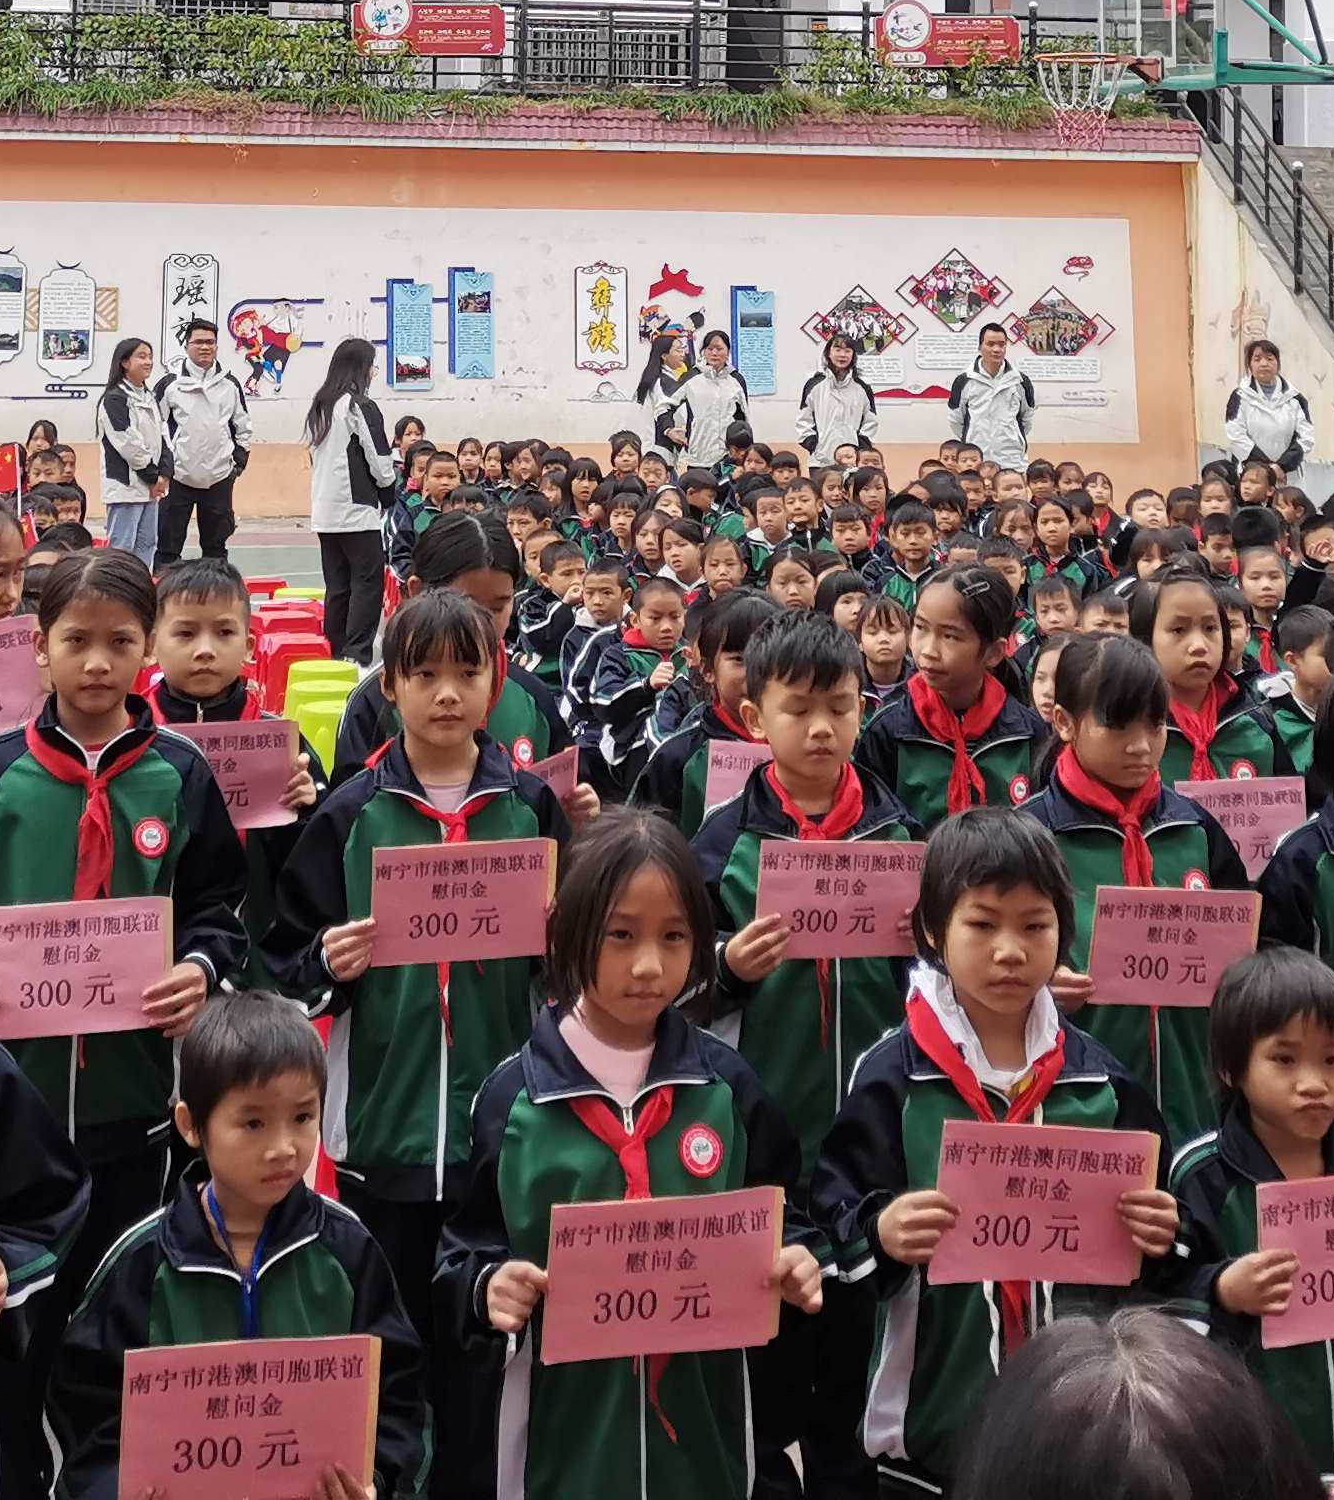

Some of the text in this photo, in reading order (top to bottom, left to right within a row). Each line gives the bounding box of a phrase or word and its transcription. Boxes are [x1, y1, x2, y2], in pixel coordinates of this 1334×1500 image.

[581, 276, 619, 355] 彝族
[224, 781, 249, 807] 元
[1195, 790, 1302, 808] 市港澳同胞联谊
[1250, 836, 1273, 860] 元
[376, 855, 544, 880] 南宁市港澳同胞联谊
[762, 851, 923, 876] 南宁市港澳同胞联谊
[432, 881, 487, 899] 慰问金
[814, 877, 867, 896] 慰问金
[408, 908, 500, 938] 300 元
[791, 906, 875, 934] 300 元
[1098, 901, 1251, 924] 南宁市港澳同胞联谊
[1147, 925, 1197, 945] 慰问金
[43, 942, 101, 964] 慰问金
[1122, 955, 1206, 983] 300 元
[20, 973, 115, 1008] 300 元
[944, 1142, 1144, 1177] 南宁市港澳同胞联谊
[1005, 1177, 1071, 1201] 慰问金
[555, 1209, 771, 1250] 南宁市港澳同胞联谊
[972, 1214, 1080, 1254] 300 元
[625, 1247, 697, 1273] 慰问金
[594, 1283, 711, 1324] 300 元
[129, 1354, 363, 1395] 南宁市港澳同胞联谊
[205, 1389, 283, 1419] 慰问金
[172, 1428, 300, 1473] 300 元
